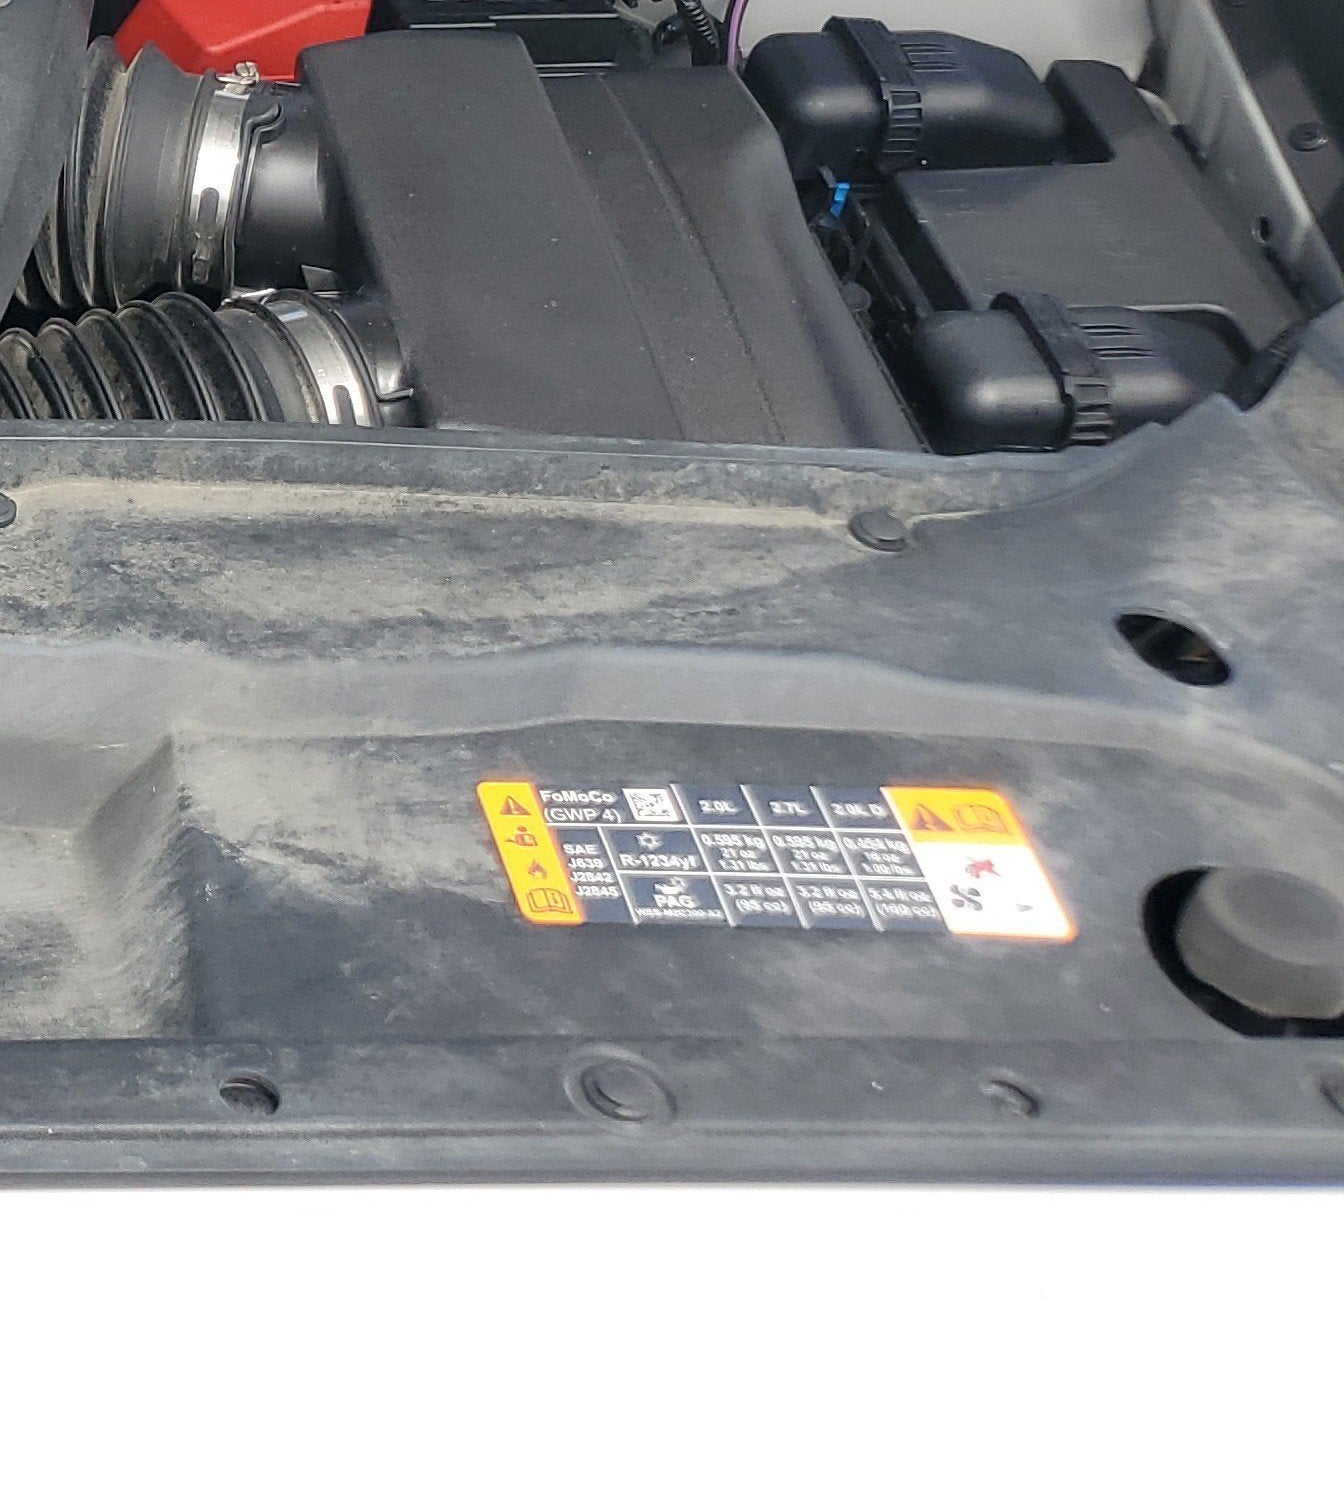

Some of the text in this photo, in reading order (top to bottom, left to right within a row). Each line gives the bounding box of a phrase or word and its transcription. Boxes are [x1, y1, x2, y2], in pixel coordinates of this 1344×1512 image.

[539, 789, 617, 803] FoMoCo
[544, 807, 622, 824] (GWP 4)
[563, 844, 597, 855] SAE
[619, 854, 698, 870] R-1234yf
[653, 895, 696, 908] PAG
